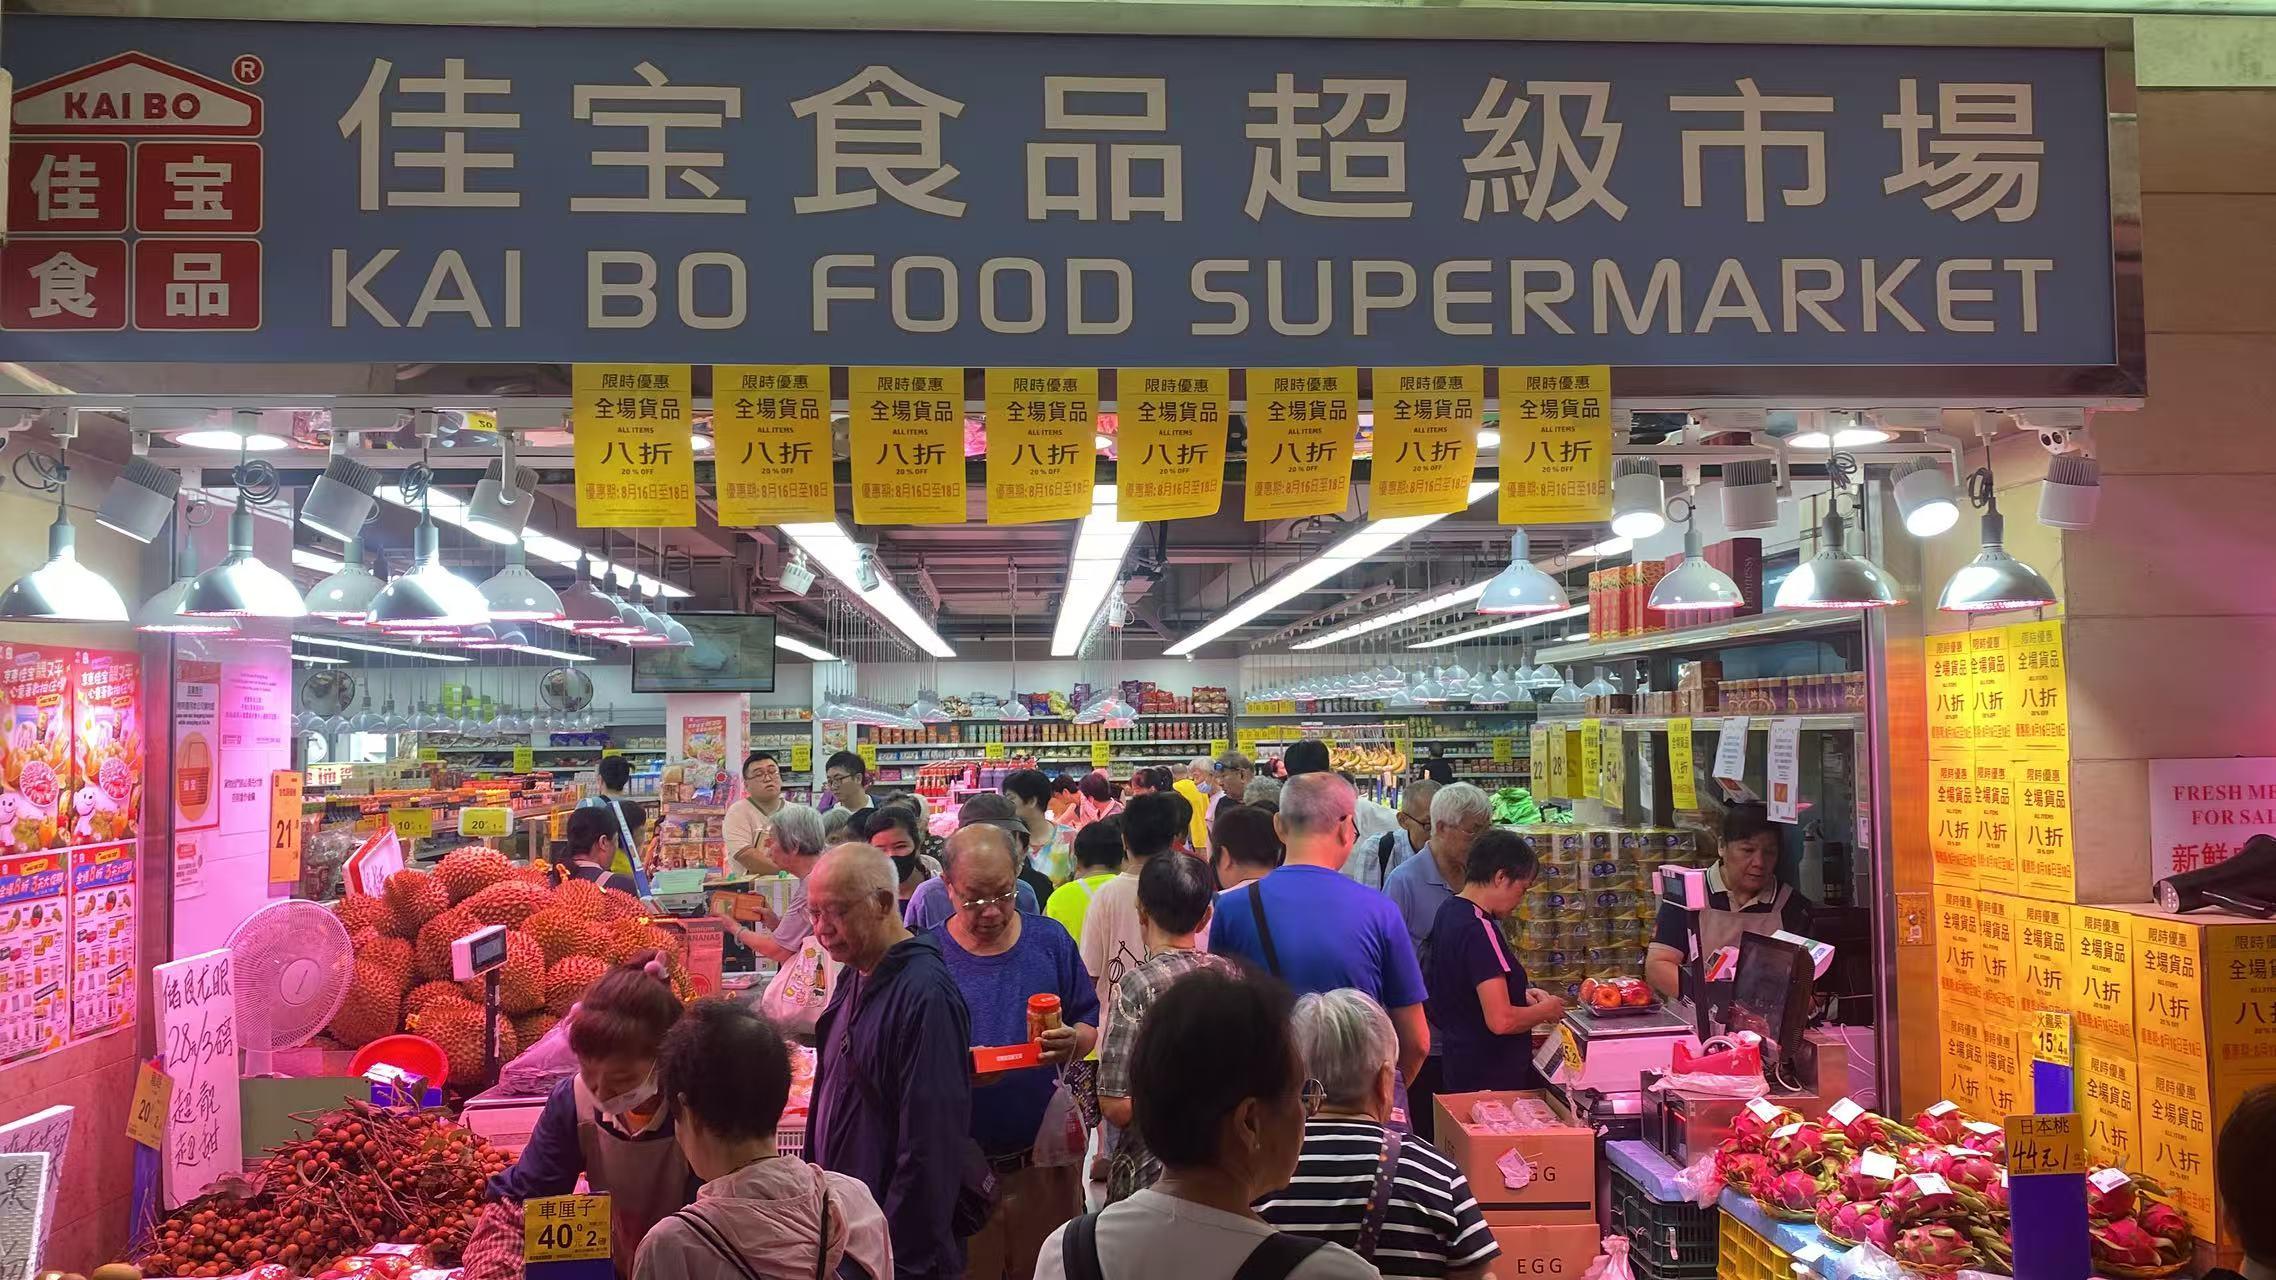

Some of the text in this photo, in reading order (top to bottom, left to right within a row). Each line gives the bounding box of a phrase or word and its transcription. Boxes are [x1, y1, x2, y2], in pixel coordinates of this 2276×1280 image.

[64, 92, 200, 119] KAI BO
[337, 57, 2044, 223] 佳宝食品超級市場
[27, 251, 229, 318] 食品
[331, 248, 2053, 336] KAI BO FOOD SUPERMARKET
[602, 374, 669, 388] 限時優惠
[742, 375, 809, 389] 限時優惠
[878, 377, 943, 391] 限時優惠
[1013, 378, 1077, 392] 限時優惠
[1145, 379, 1208, 392] 限時優惠
[1274, 377, 1337, 391] 限時優惠
[1400, 376, 1463, 391] 限時優惠
[1526, 376, 1589, 391] 限時優惠
[595, 398, 679, 420] 全場貨品
[736, 398, 819, 420] 全場貨品
[871, 400, 953, 422] 全場貨品
[1007, 401, 1087, 422] 全場貨品
[1138, 402, 1217, 423] 全場貨品
[1268, 400, 1346, 422] 全場貨品
[1394, 399, 1472, 420] 全場貨品
[1520, 399, 1599, 420] 全場貨品
[601, 442, 672, 465] 八折
[742, 442, 813, 464] 八折
[876, 443, 946, 465] 八折
[1011, 444, 1079, 465] 八折
[1141, 444, 1208, 464] 八折
[1270, 442, 1337, 464] 八折
[1396, 440, 1462, 463] 八折
[1524, 440, 1592, 463] 八折
[2018, 650, 2059, 670] 全場貨品
[1937, 694, 1964, 712] 八折
[1974, 692, 2003, 710] 八折
[2022, 688, 2057, 708] 八折
[1534, 762, 1542, 779] 22
[1553, 757, 1562, 775] 28
[1607, 761, 1617, 782] 54
[1938, 786, 1971, 803] 全場貨品
[1976, 786, 2009, 805] 全場貨品
[2024, 788, 2065, 808] 全場貨品
[2173, 784, 2241, 800] FRESH
[472, 820, 484, 829] 20
[2192, 810, 2234, 825] FOR
[276, 820, 291, 848] 21
[1939, 820, 1969, 839] 八折
[1978, 821, 2007, 842] 八折
[2028, 826, 2063, 847] 八折
[2173, 843, 2245, 872] 新鮮
[1981, 920, 2009, 942] 場貨品
[2084, 916, 2120, 934] 限時優惠
[2024, 928, 2065, 952] 全場貨品
[2149, 928, 2187, 947] 限時優惠
[1947, 947, 1974, 968] 八折
[2081, 937, 2125, 963] 全場貨品
[2145, 950, 2194, 979] 全場貨品
[2027, 966, 2062, 990] 八折
[2083, 976, 2120, 1004] 八折
[2149, 992, 2189, 1021] 八折
[2091, 1058, 2126, 1081] 限時優惠
[1952, 1074, 1979, 1099] 八折
[2087, 1078, 2131, 1112] 全場貨品
[2156, 1076, 2196, 1101] 限時優惠
[2021, 1117, 2069, 1134] 日本桃
[2152, 1099, 2203, 1133] 全場貨品
[2090, 1119, 2128, 1151] 八折
[2156, 1142, 2200, 1176] 八折
[1529, 1167, 1556, 1181] GG
[539, 1199, 595, 1219] 車厘子
[1518, 1259, 1561, 1274] EGG
